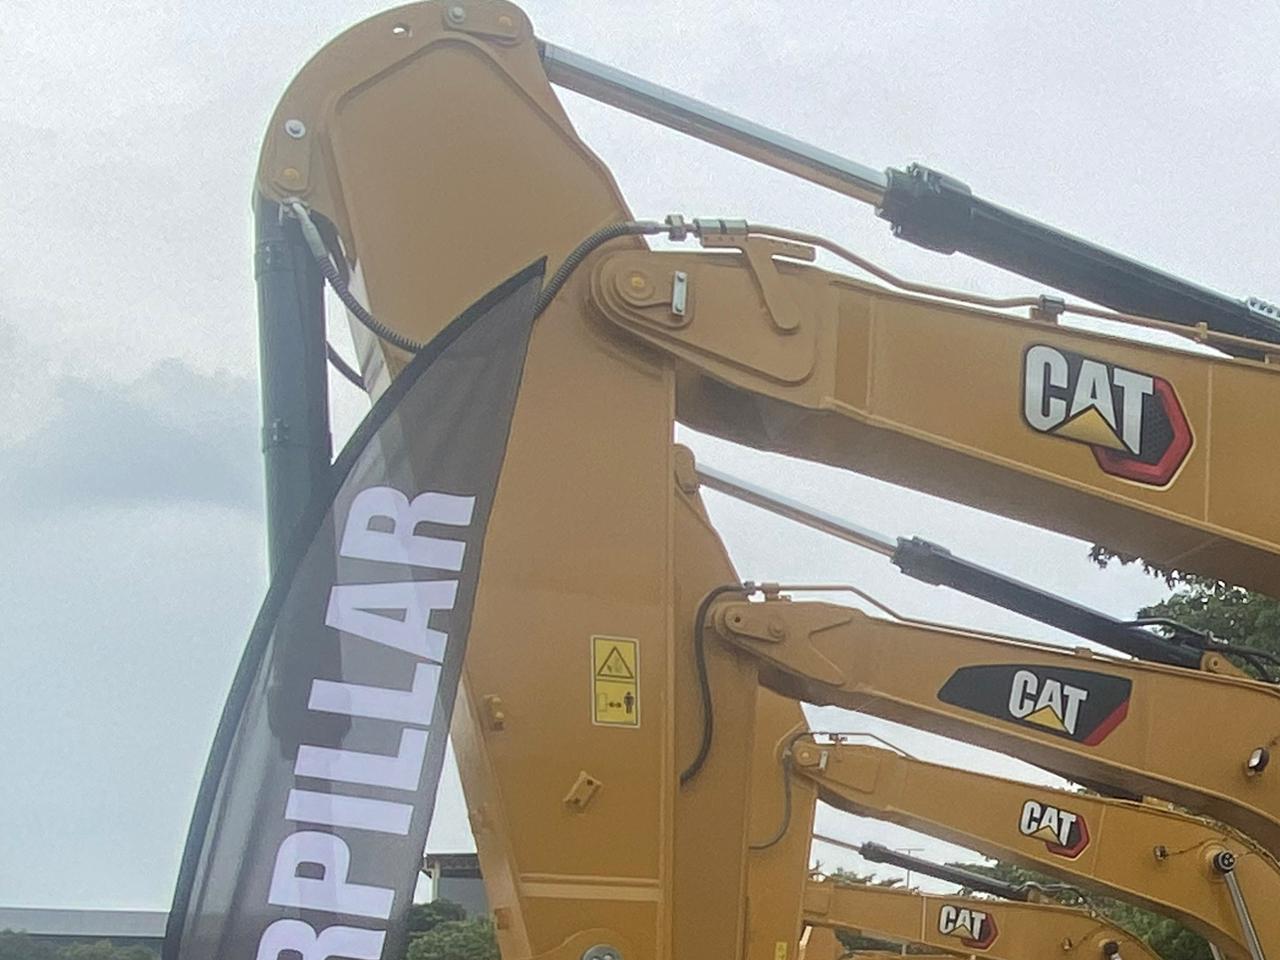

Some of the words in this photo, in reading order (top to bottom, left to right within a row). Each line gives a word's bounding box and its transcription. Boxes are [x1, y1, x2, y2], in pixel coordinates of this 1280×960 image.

[1023, 345, 1154, 456] CAT
[1009, 670, 1087, 735] CAT
[1020, 801, 1077, 846] CAT
[940, 905, 986, 940] CAT
